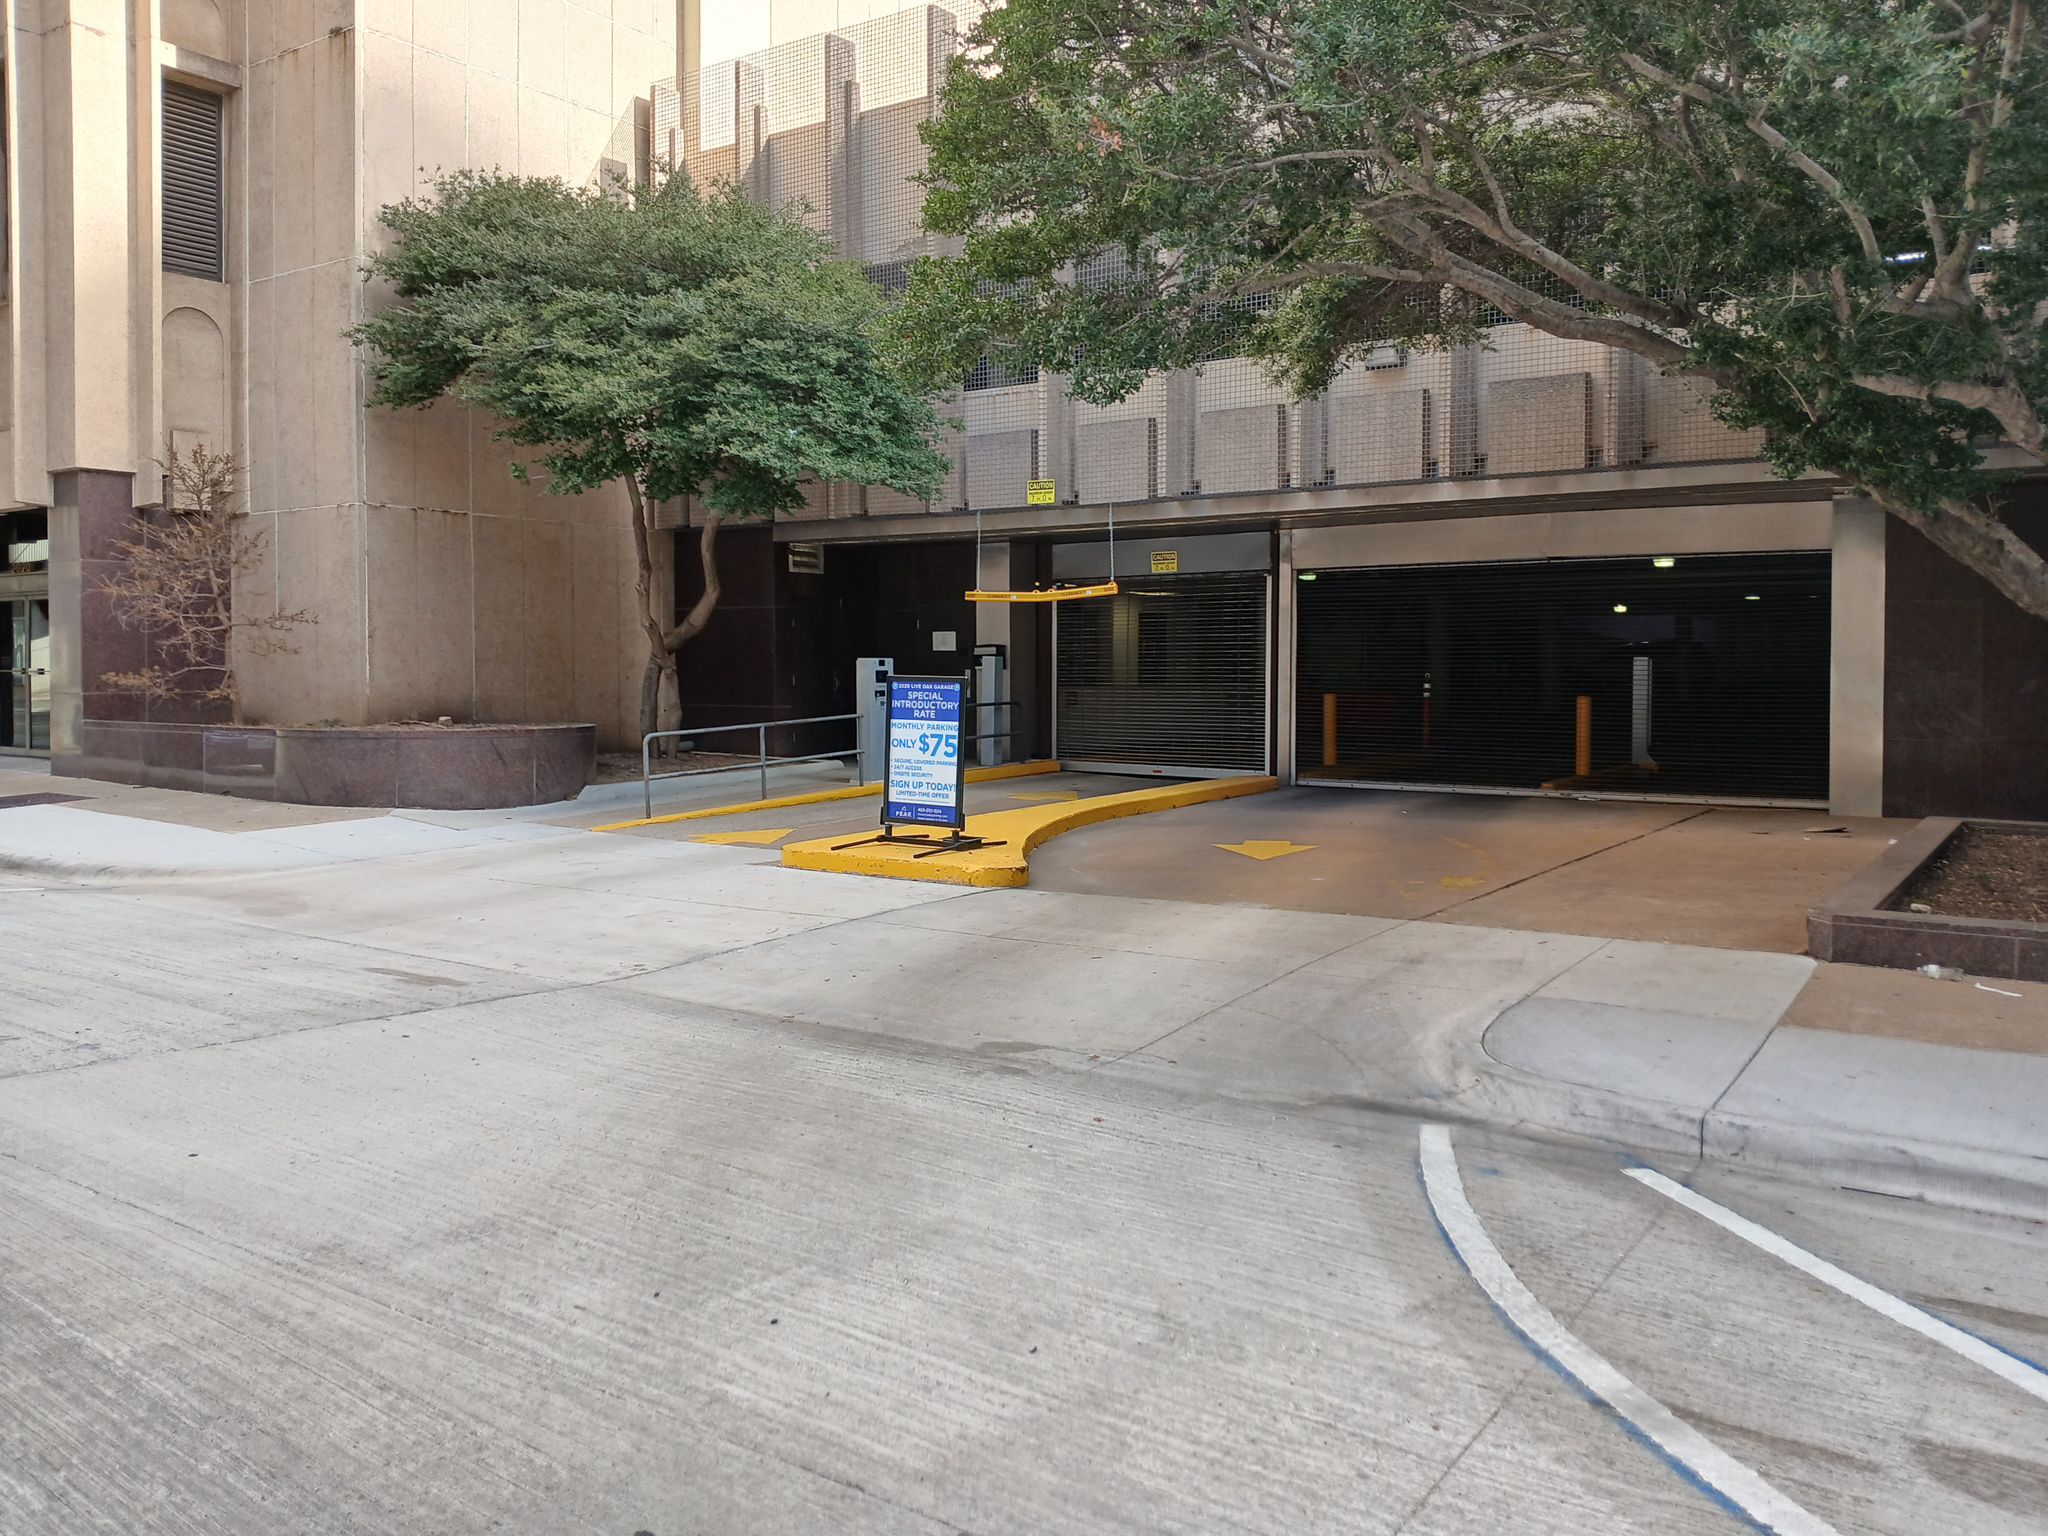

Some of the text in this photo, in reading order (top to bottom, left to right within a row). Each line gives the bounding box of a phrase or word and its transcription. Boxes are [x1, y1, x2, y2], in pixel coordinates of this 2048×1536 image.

[1029, 482, 1053, 490] CAUTION
[907, 691, 943, 700] SPECIAL
[891, 700, 959, 710] INTRODUCTORY
[913, 709, 936, 718] RATE
[891, 722, 959, 731] MONTHLY PARKING
[891, 732, 957, 758] ONLY $75
[890, 779, 956, 792] SIGN UP TODAY!
[896, 790, 930, 798] LIMITED-TIME
[895, 810, 912, 818] PEAK
